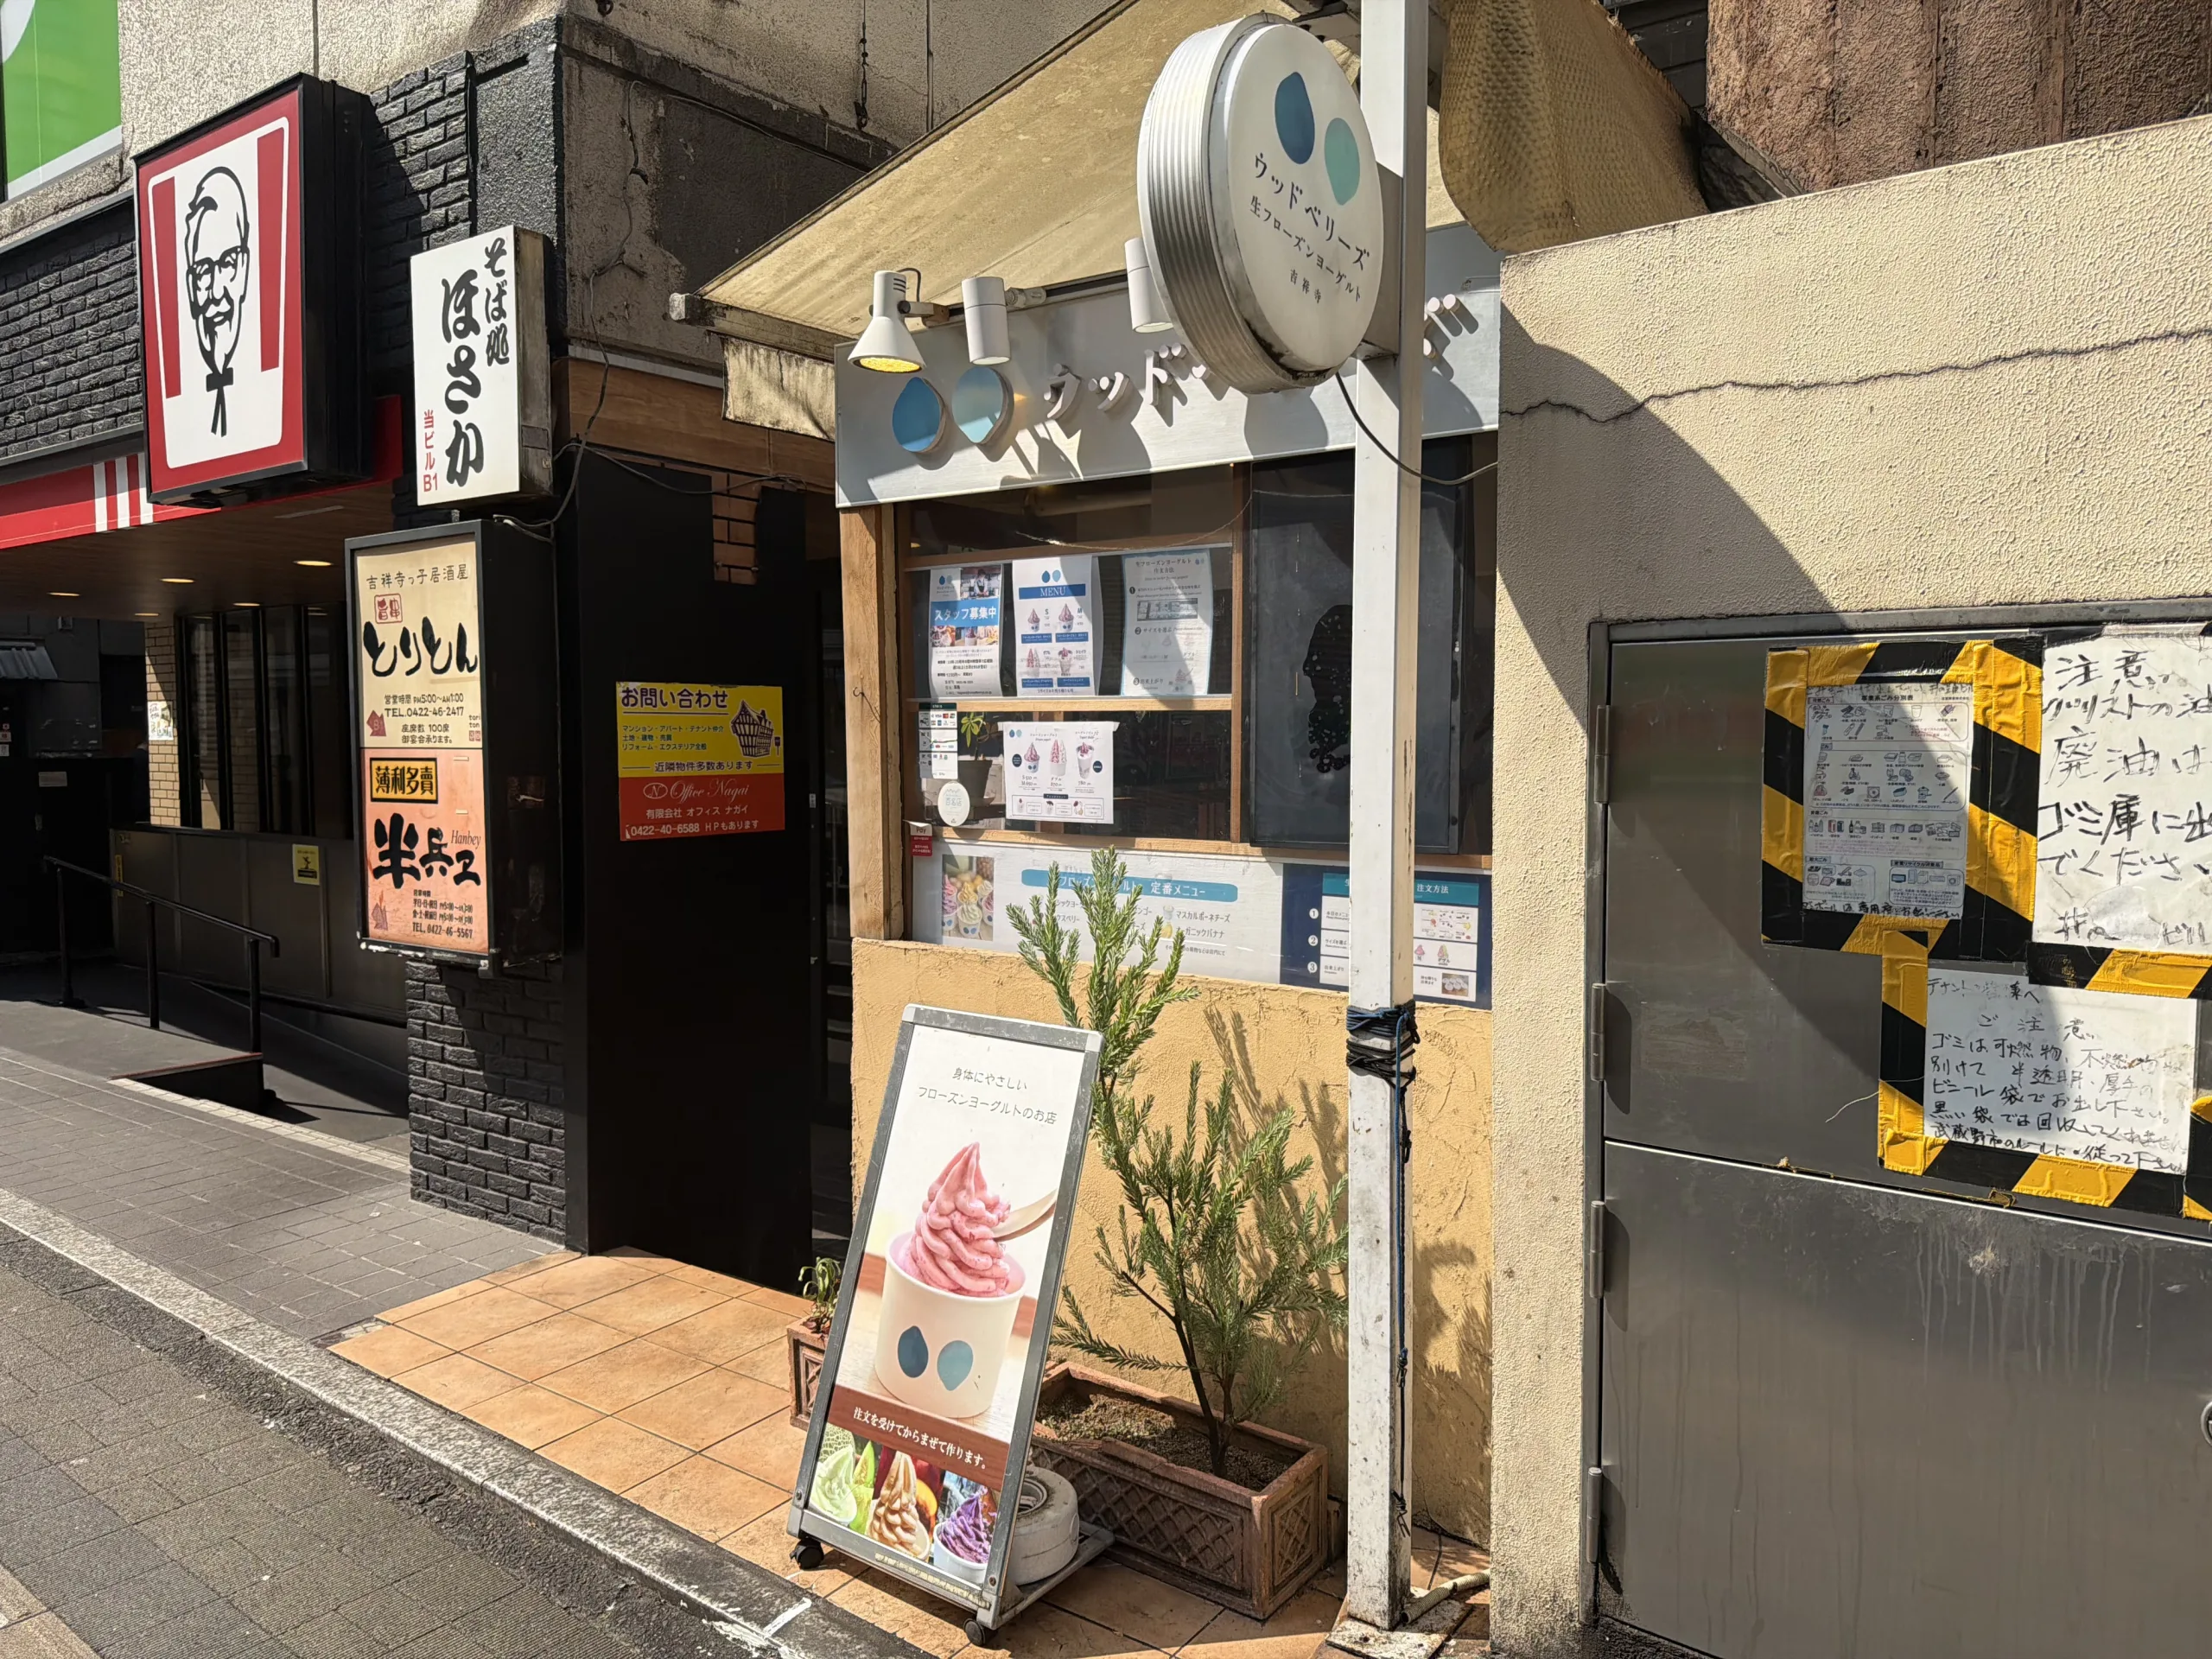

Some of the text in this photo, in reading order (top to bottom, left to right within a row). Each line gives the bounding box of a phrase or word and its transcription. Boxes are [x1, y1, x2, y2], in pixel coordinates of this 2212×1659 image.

[1255, 152, 1371, 271] ウッドベリーズ
[1249, 194, 1362, 302] 生フローズンヨーグルト
[484, 237, 510, 367] そば処
[441, 269, 485, 487] ほさか
[423, 409, 439, 492] 当ビルB1
[366, 563, 468, 590] 吉祥寺っ子居酒屋
[1039, 587, 1066, 597] MENU
[934, 607, 997, 621] スタッフ募集中
[363, 616, 478, 677] とりとん
[2055, 650, 2171, 694] 注意
[385, 694, 411, 705] 営業時間
[621, 687, 728, 709] お問い合わせ
[385, 706, 465, 718] TEL.0422-46-2417
[429, 723, 449, 733] 100席
[654, 761, 753, 772] 近隣物件多数あります
[670, 780, 705, 804] Office
[707, 778, 750, 804] Nagai
[646, 804, 748, 820] 有限会社 オフィス ナガイ
[631, 820, 759, 836] 0422-40-6588 HPもあります
[450, 830, 481, 850] Hanbey
[1150, 880, 1206, 897] 定番メニュー
[1416, 883, 1450, 894] 注文方法
[951, 1067, 1027, 1090] 身体にやさしい
[918, 1086, 1058, 1125] フローズンヨーグルトのお店
[852, 1406, 986, 1469] 注文を受けてからまぜて作ります。
